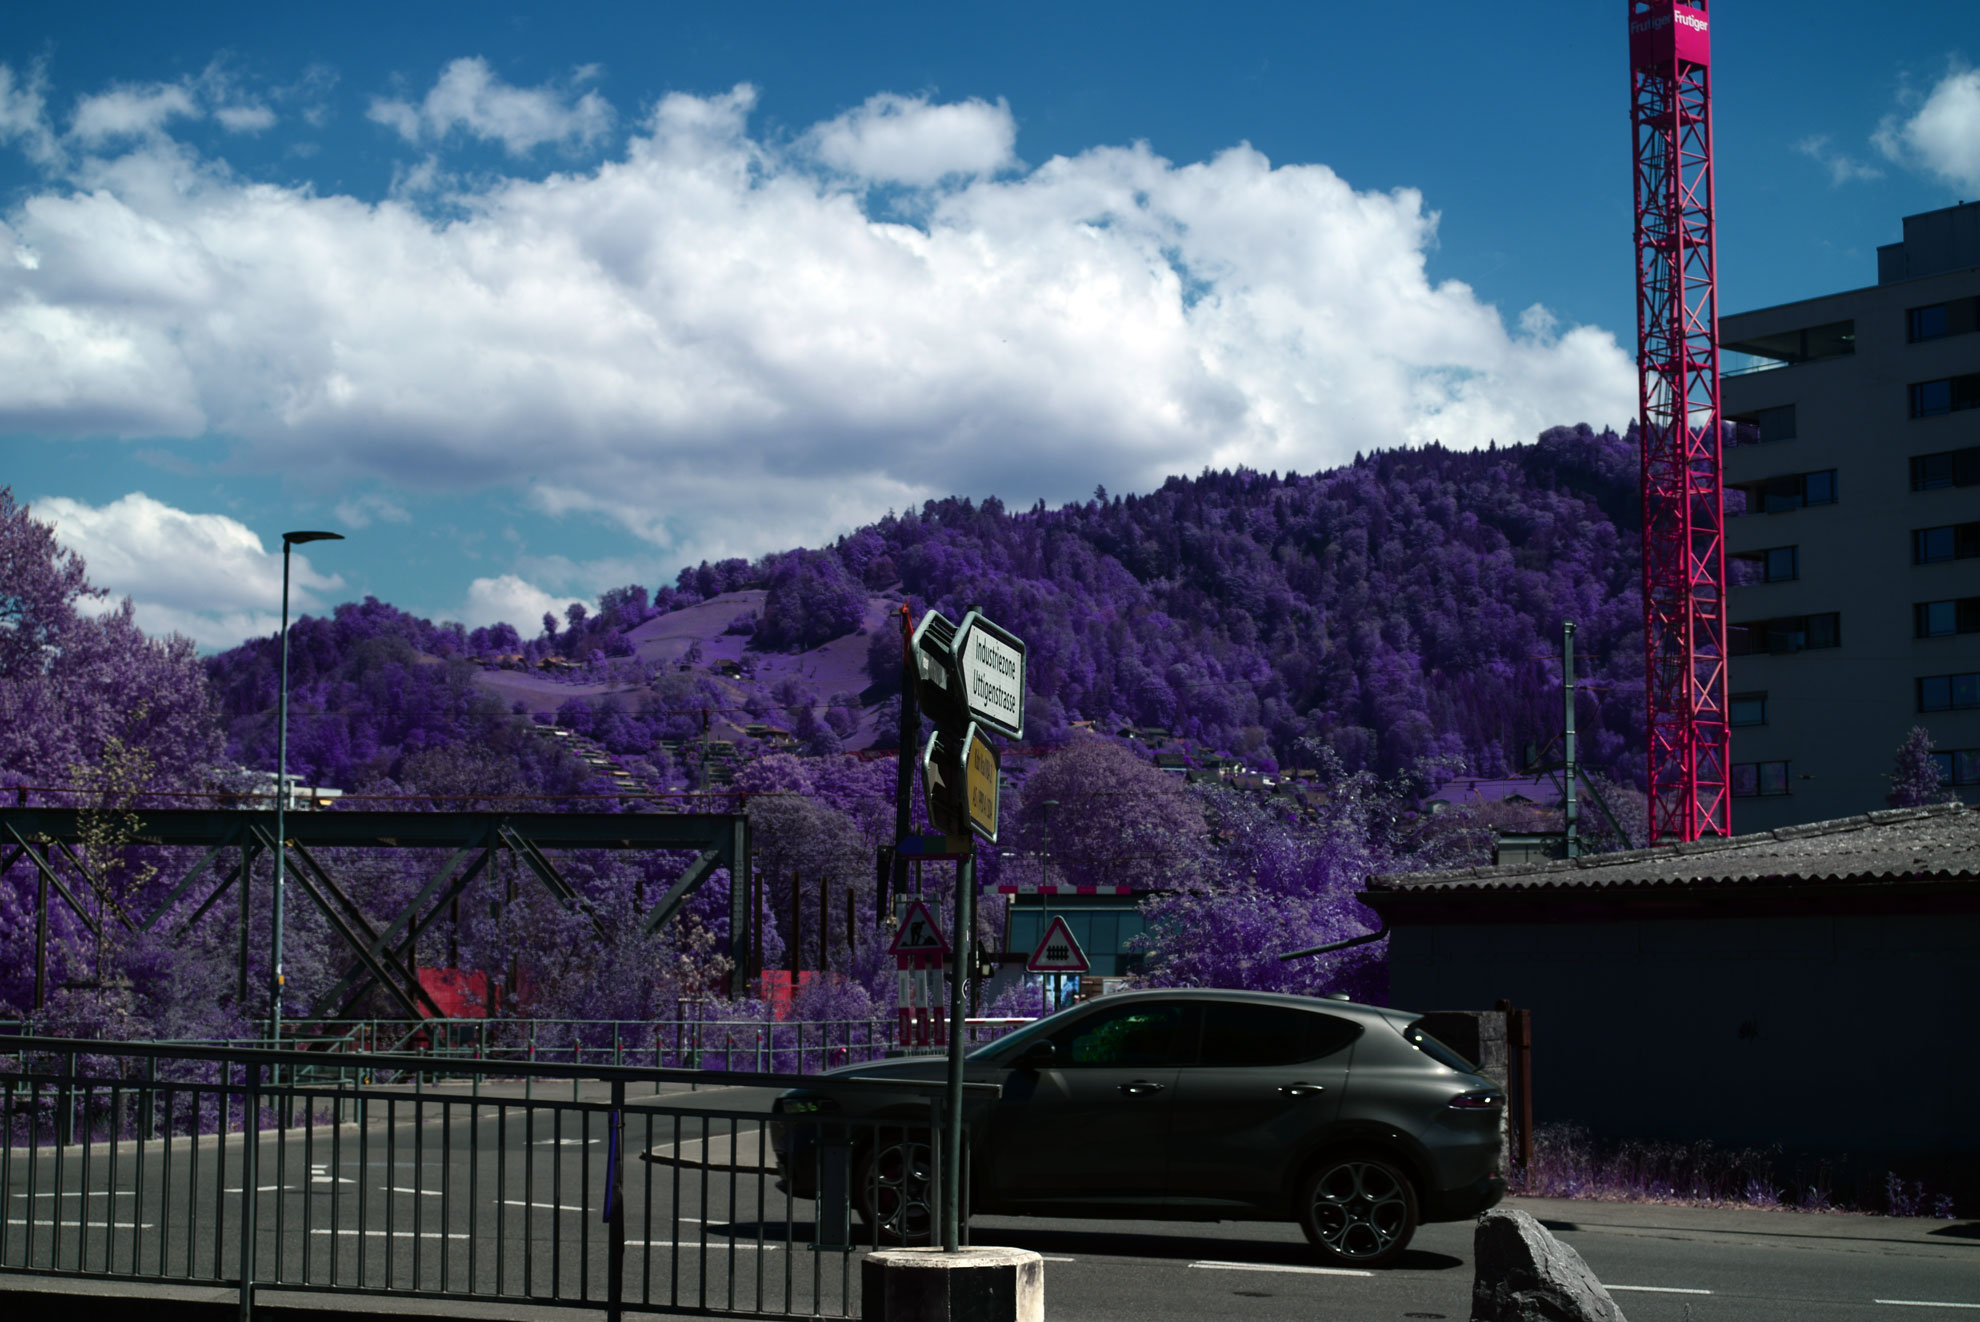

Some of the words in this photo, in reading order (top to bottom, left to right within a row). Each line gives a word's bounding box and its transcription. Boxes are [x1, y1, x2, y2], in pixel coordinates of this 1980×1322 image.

[1631, 14, 1672, 35] Frutiger
[1674, 9, 1708, 32] Frutiger
[975, 634, 1015, 680] Industriezone
[973, 668, 1015, 713] Uttigenstrasse
